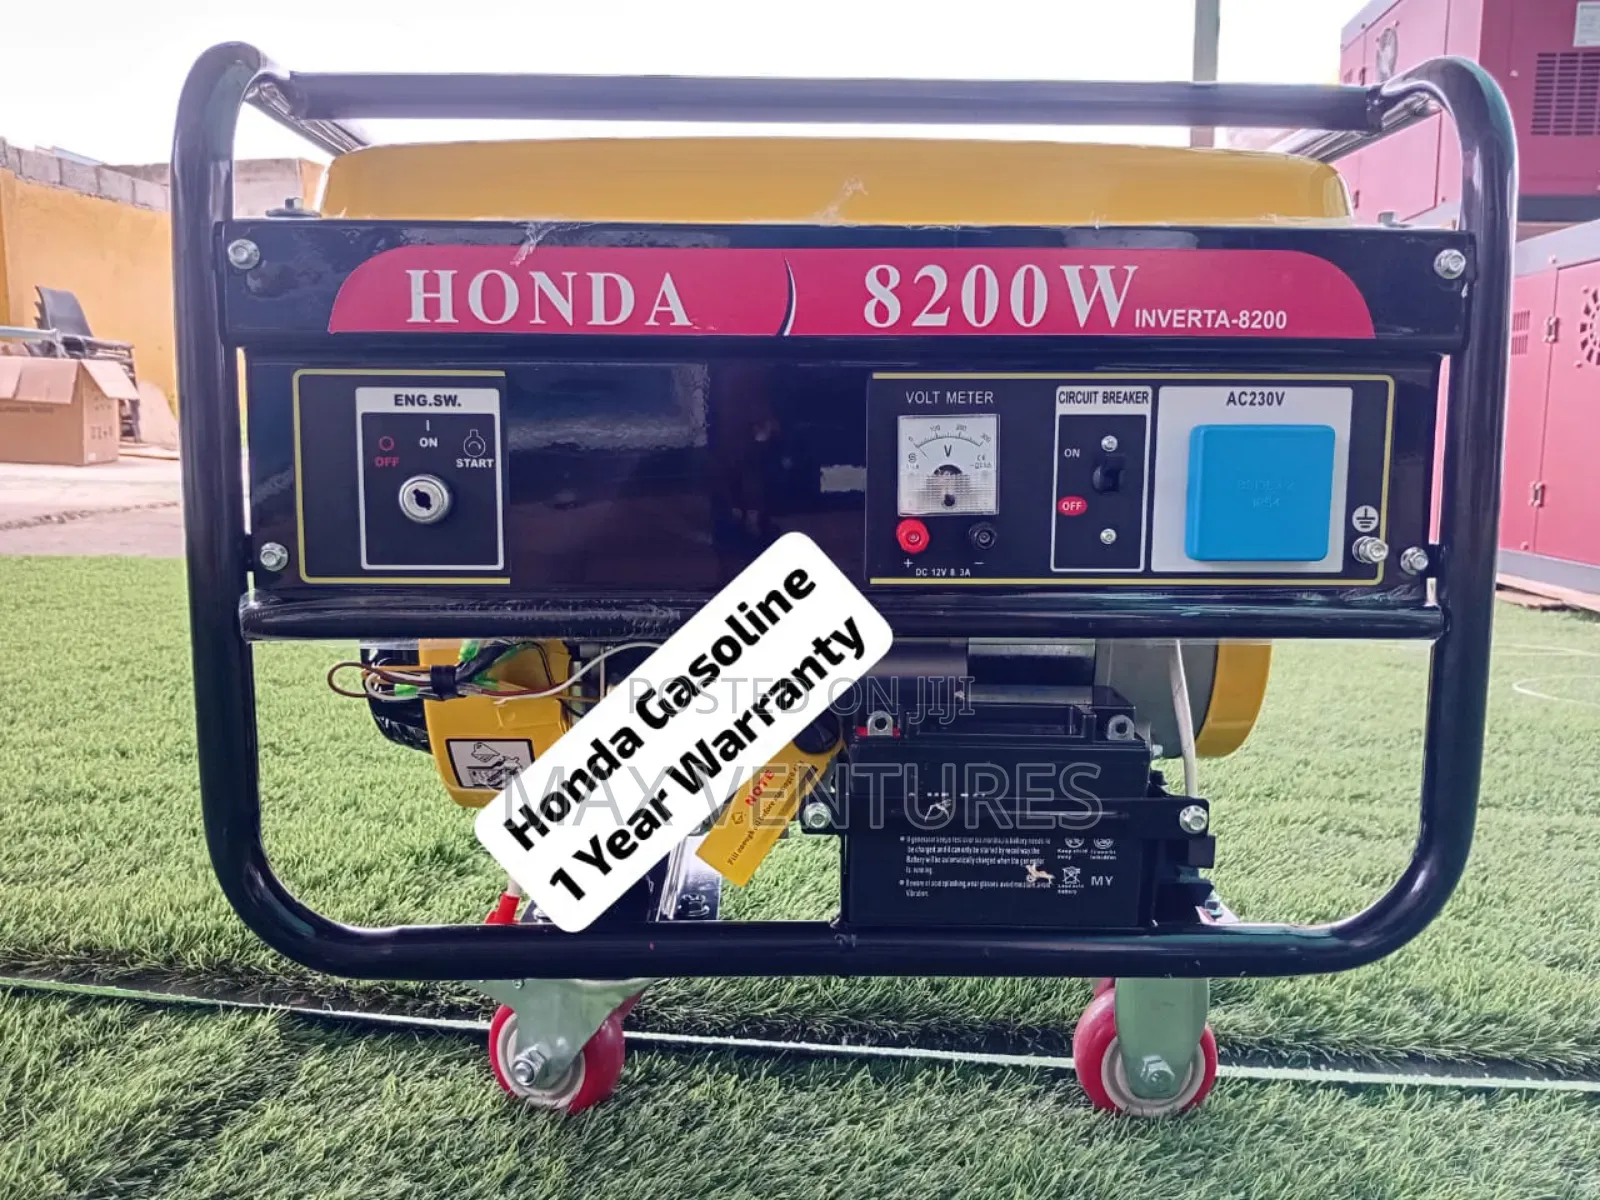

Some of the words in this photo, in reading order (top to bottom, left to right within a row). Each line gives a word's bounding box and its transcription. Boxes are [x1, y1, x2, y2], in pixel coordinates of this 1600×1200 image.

[405, 269, 693, 326] HONDA
[863, 263, 1139, 328] 8200W
[1134, 308, 1288, 330] INVERTA-8200
[394, 394, 462, 407] ENG.SW.
[905, 391, 940, 404] VOLT
[946, 391, 994, 404] METER
[1058, 391, 1099, 405] CIRCUIT
[1102, 391, 1149, 405] BREAKER
[1225, 391, 1286, 406] AC230V
[419, 437, 438, 448] ON
[944, 444, 952, 458] V
[1064, 448, 1080, 458] ON
[375, 456, 400, 468] OFF
[456, 458, 495, 468] START
[1062, 501, 1082, 511] OFF
[915, 568, 928, 577] DC
[931, 568, 947, 577] 12V
[745, 769, 775, 806] NOTE
[1090, 875, 1114, 886] MY
